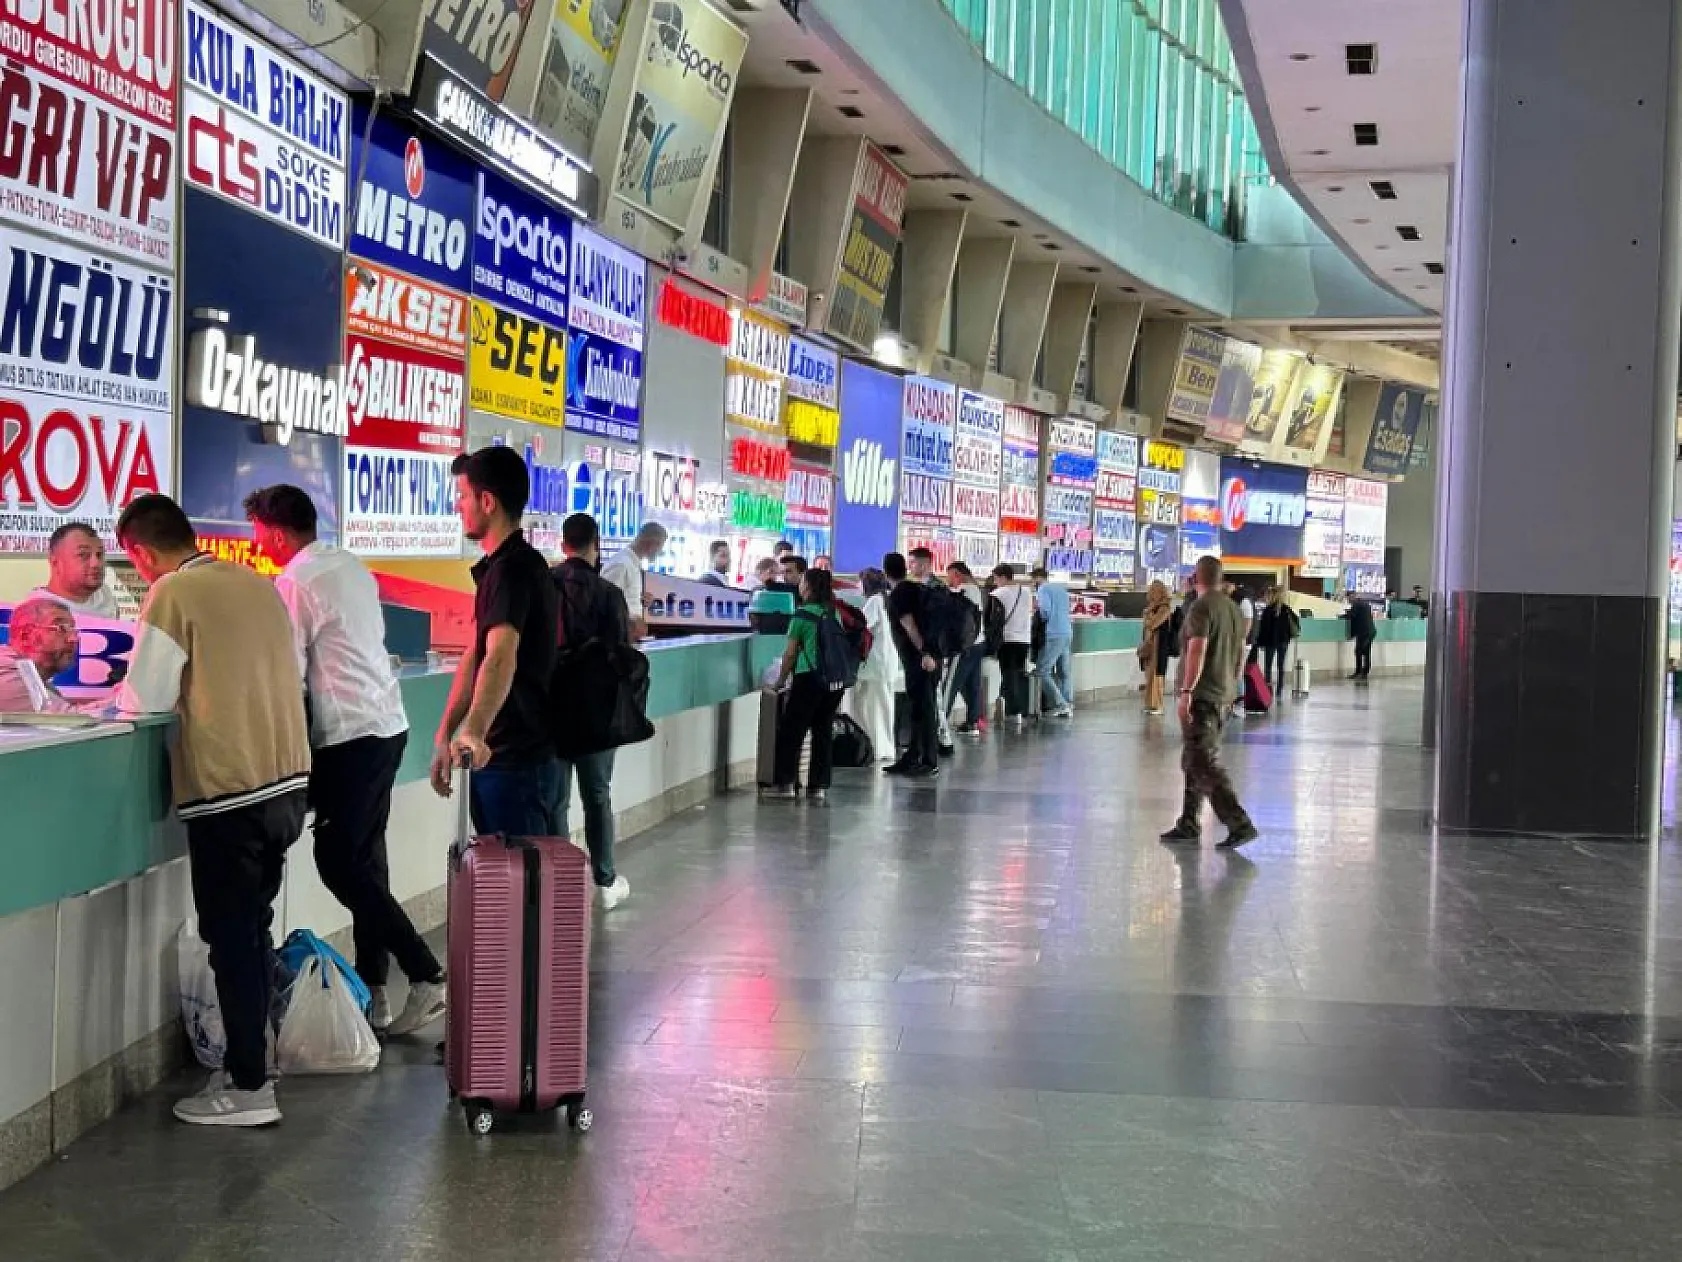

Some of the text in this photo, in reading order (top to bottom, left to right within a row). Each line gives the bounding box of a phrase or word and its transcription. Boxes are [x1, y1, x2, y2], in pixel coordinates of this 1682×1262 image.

[0, 21, 31, 58] RDU
[188, 8, 258, 115] KULA
[277, 146, 331, 191] SÖKE
[356, 181, 466, 271] METRO
[477, 172, 566, 276] Isparta
[349, 268, 466, 345] AKSEL
[490, 307, 564, 396] SEÇ
[347, 453, 405, 516] TOKAT
[844, 438, 896, 508] Villa
[647, 592, 750, 619] efe tur
